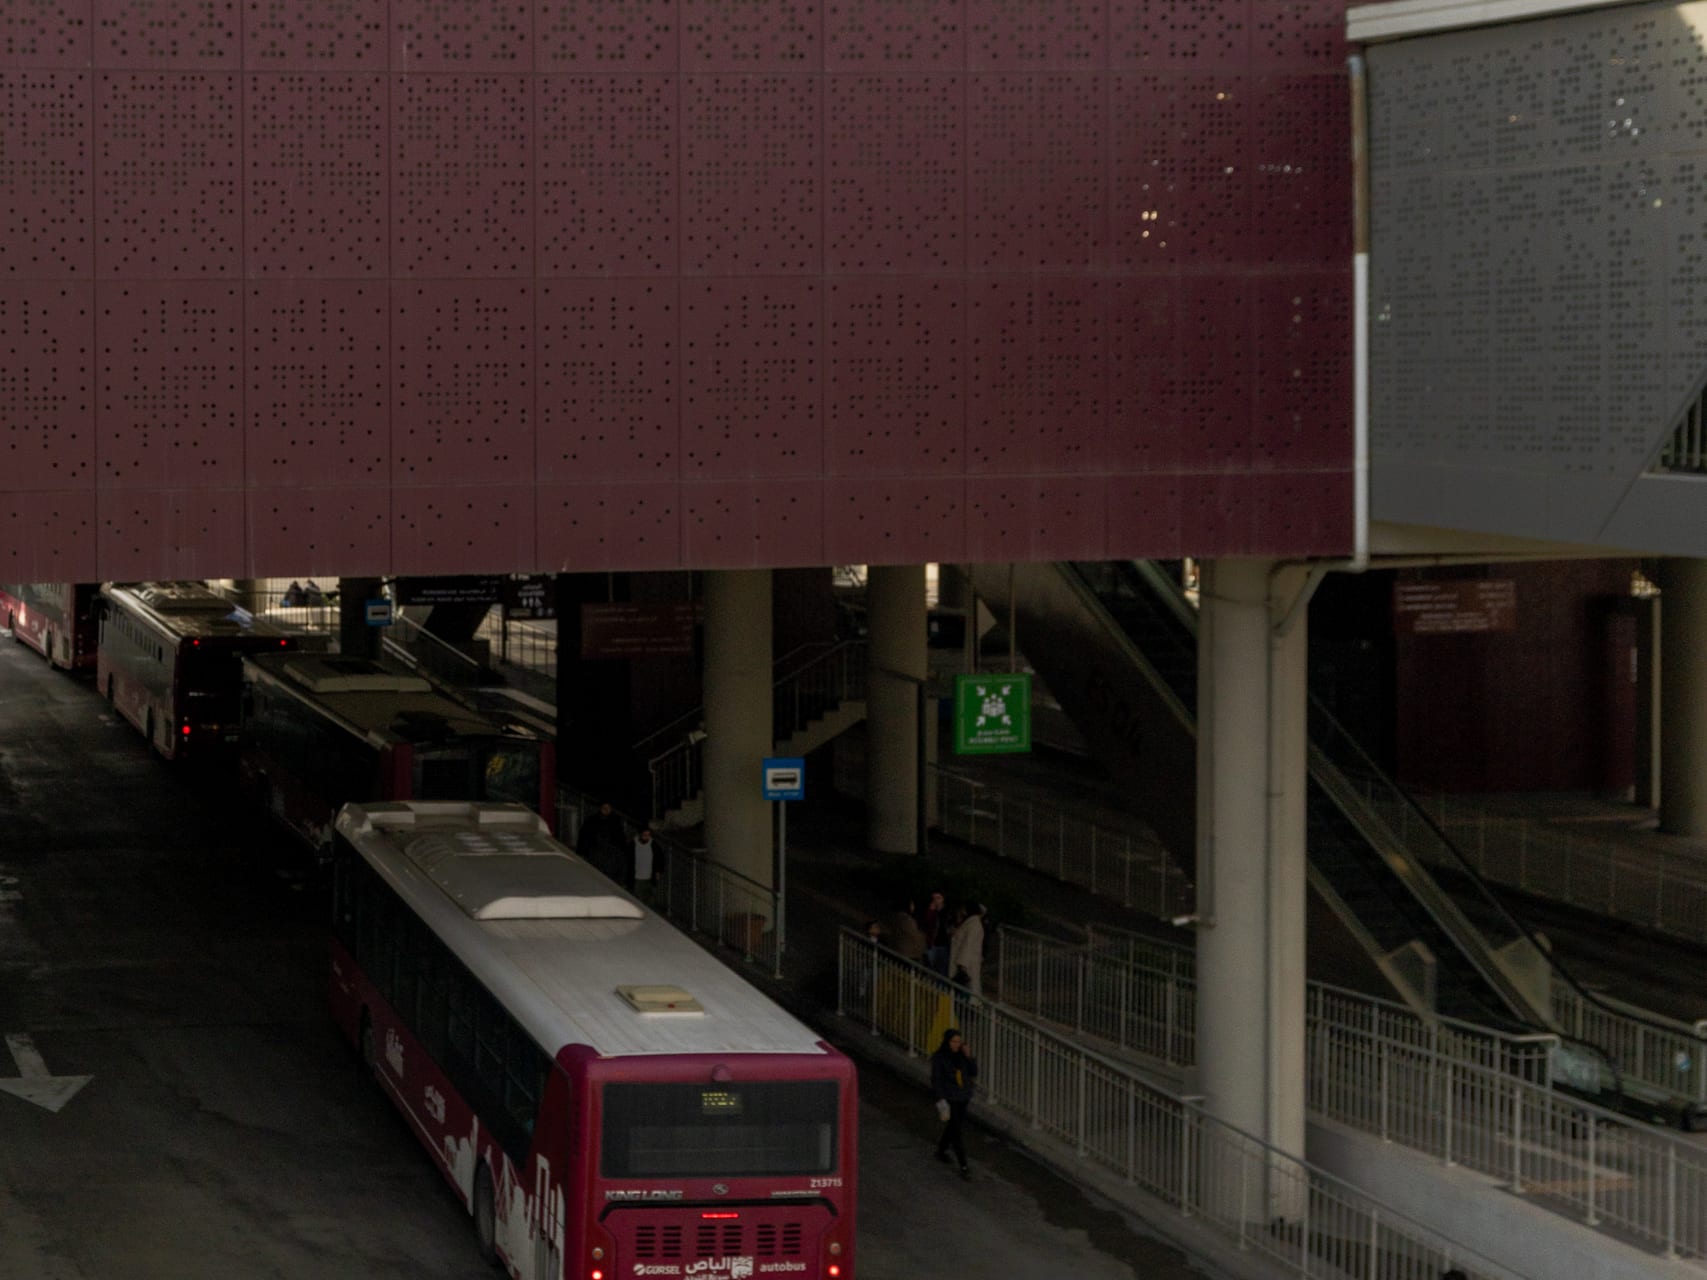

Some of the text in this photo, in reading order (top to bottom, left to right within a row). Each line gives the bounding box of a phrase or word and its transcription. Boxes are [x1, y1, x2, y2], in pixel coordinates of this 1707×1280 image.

[604, 1190, 683, 1201] KING LONG
[685, 1256, 731, 1274] الباص
[759, 1261, 807, 1272] autobus
